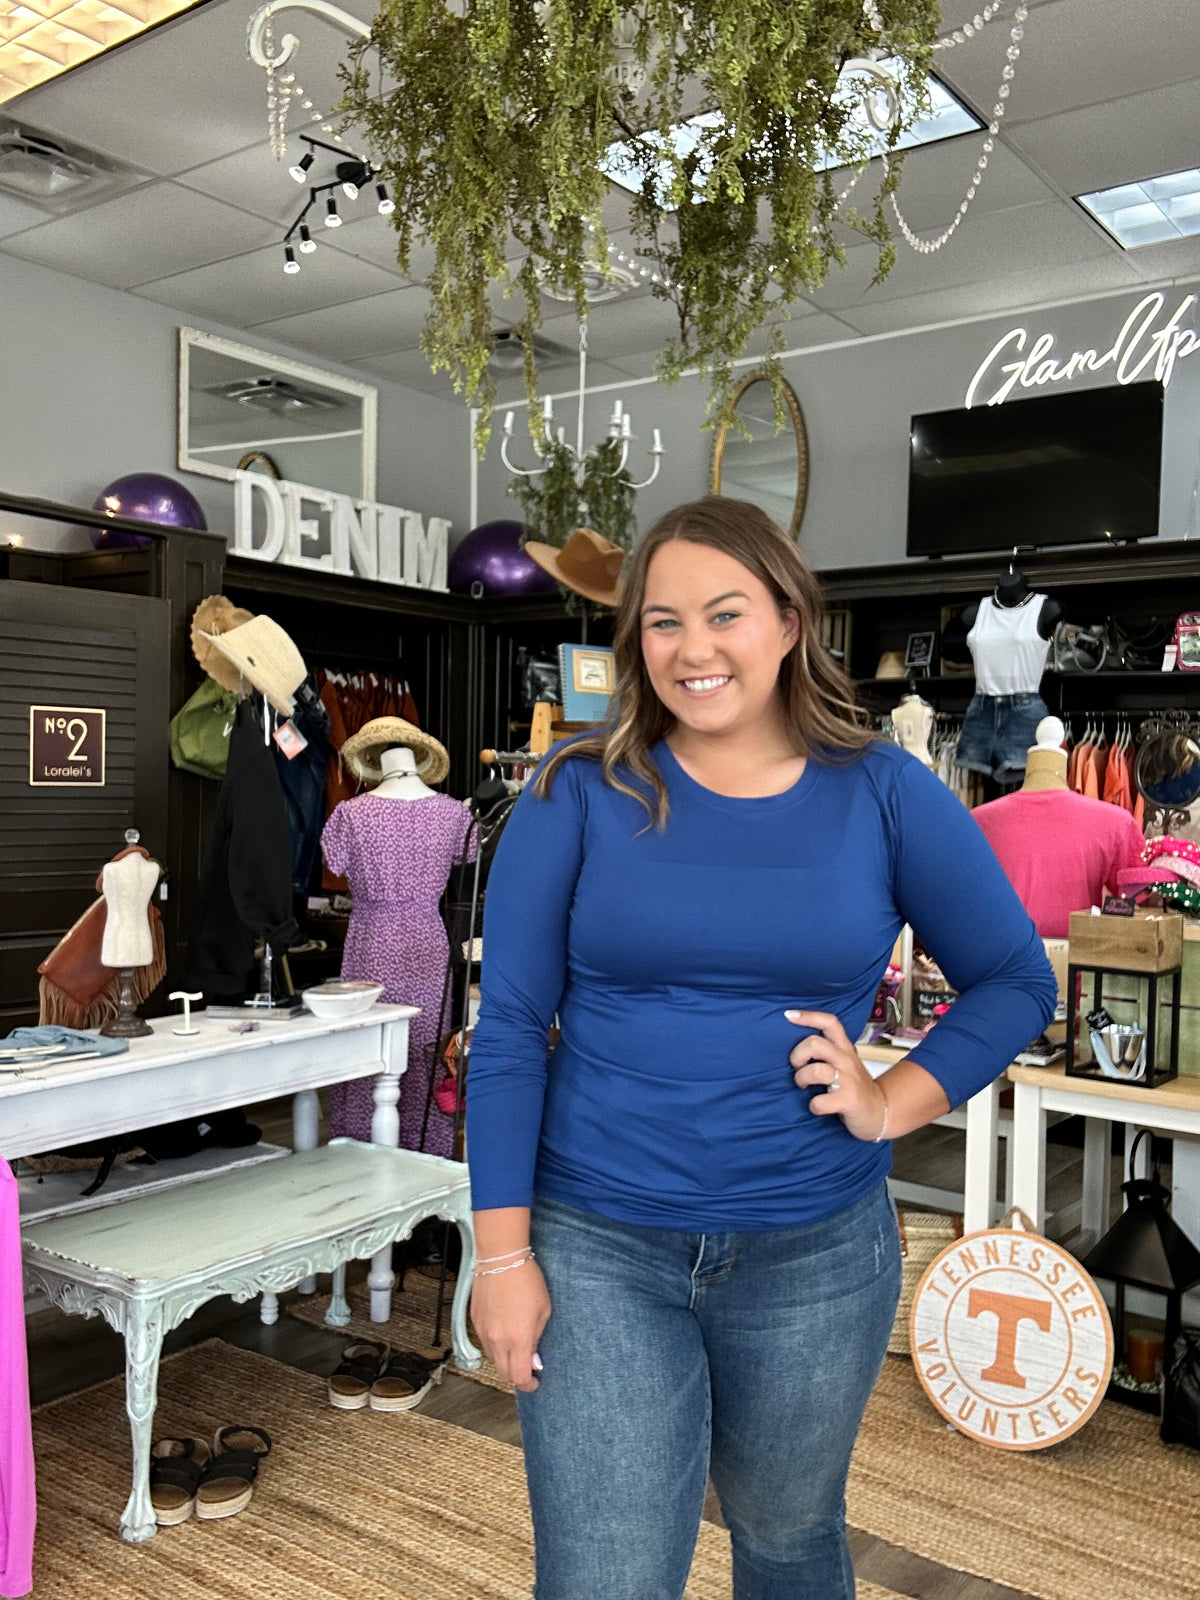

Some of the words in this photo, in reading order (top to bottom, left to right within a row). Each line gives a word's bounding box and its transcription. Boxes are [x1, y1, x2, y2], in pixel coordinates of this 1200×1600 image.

[965, 328, 1112, 409] Glam
[1111, 292, 1200, 388] Up
[230, 469, 452, 593] DENIM
[67, 718, 88, 761] 2
[927, 1240, 1097, 1323] TENNESSEE
[919, 1338, 1100, 1439] VOLUNTEERS
[967, 1287, 1052, 1389] T
